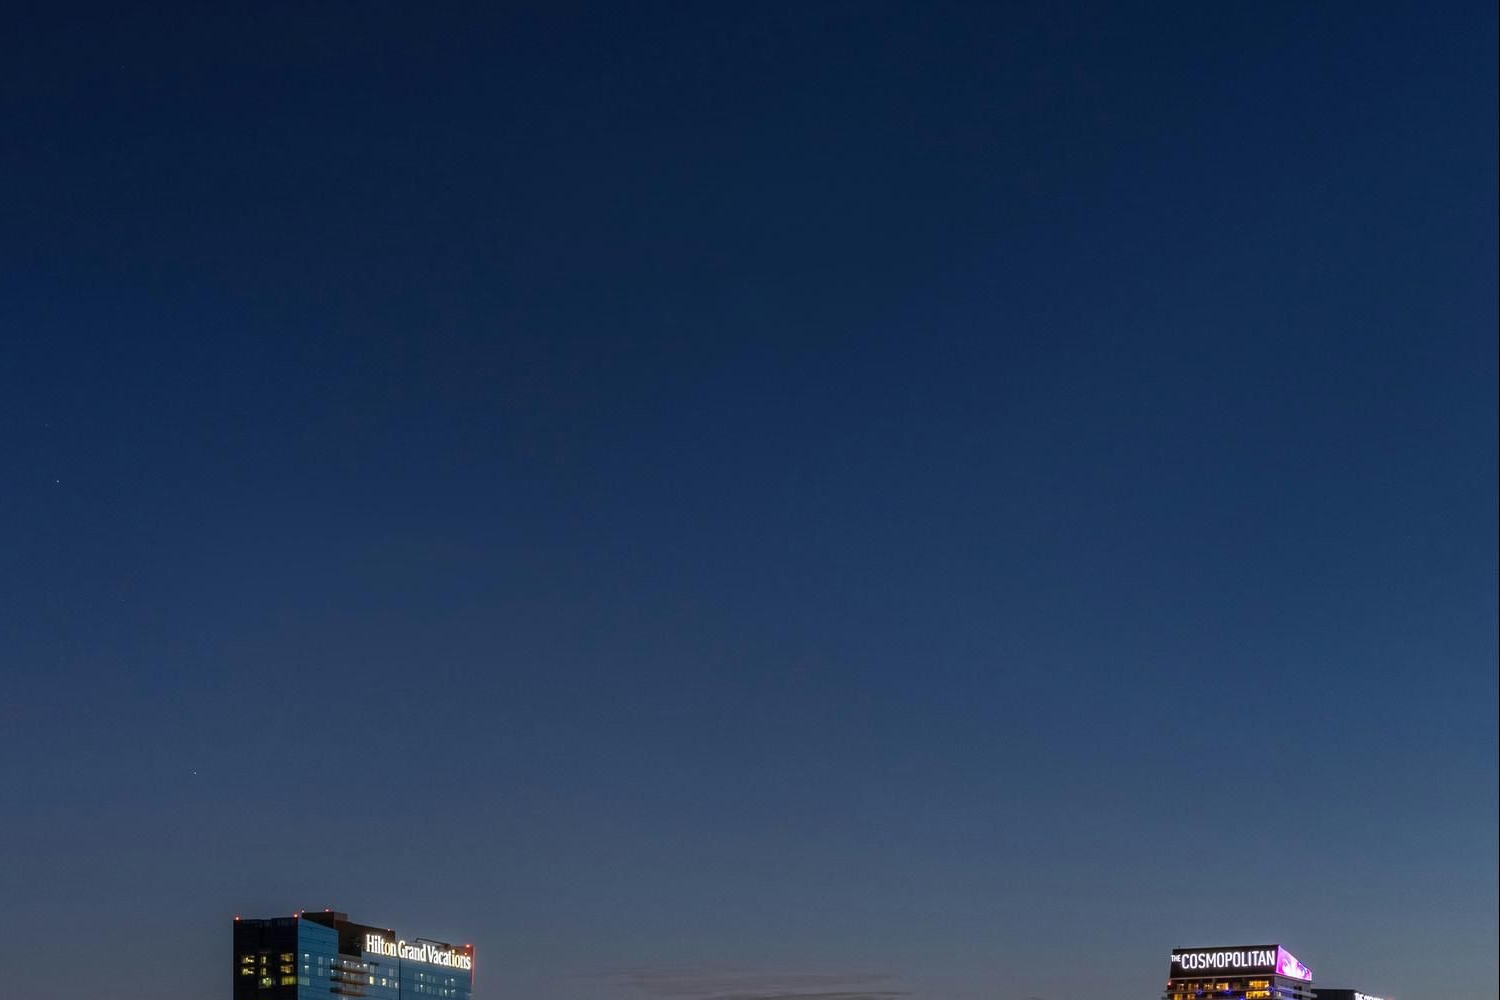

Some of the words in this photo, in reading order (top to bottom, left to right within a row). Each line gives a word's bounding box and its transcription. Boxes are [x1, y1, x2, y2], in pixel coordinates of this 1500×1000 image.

[366, 934, 397, 957] Hilton
[398, 940, 427, 962] Grand
[426, 945, 471, 970] Vacations
[1171, 954, 1181, 963] THE
[1181, 950, 1276, 969] COSMOPOLITAN
